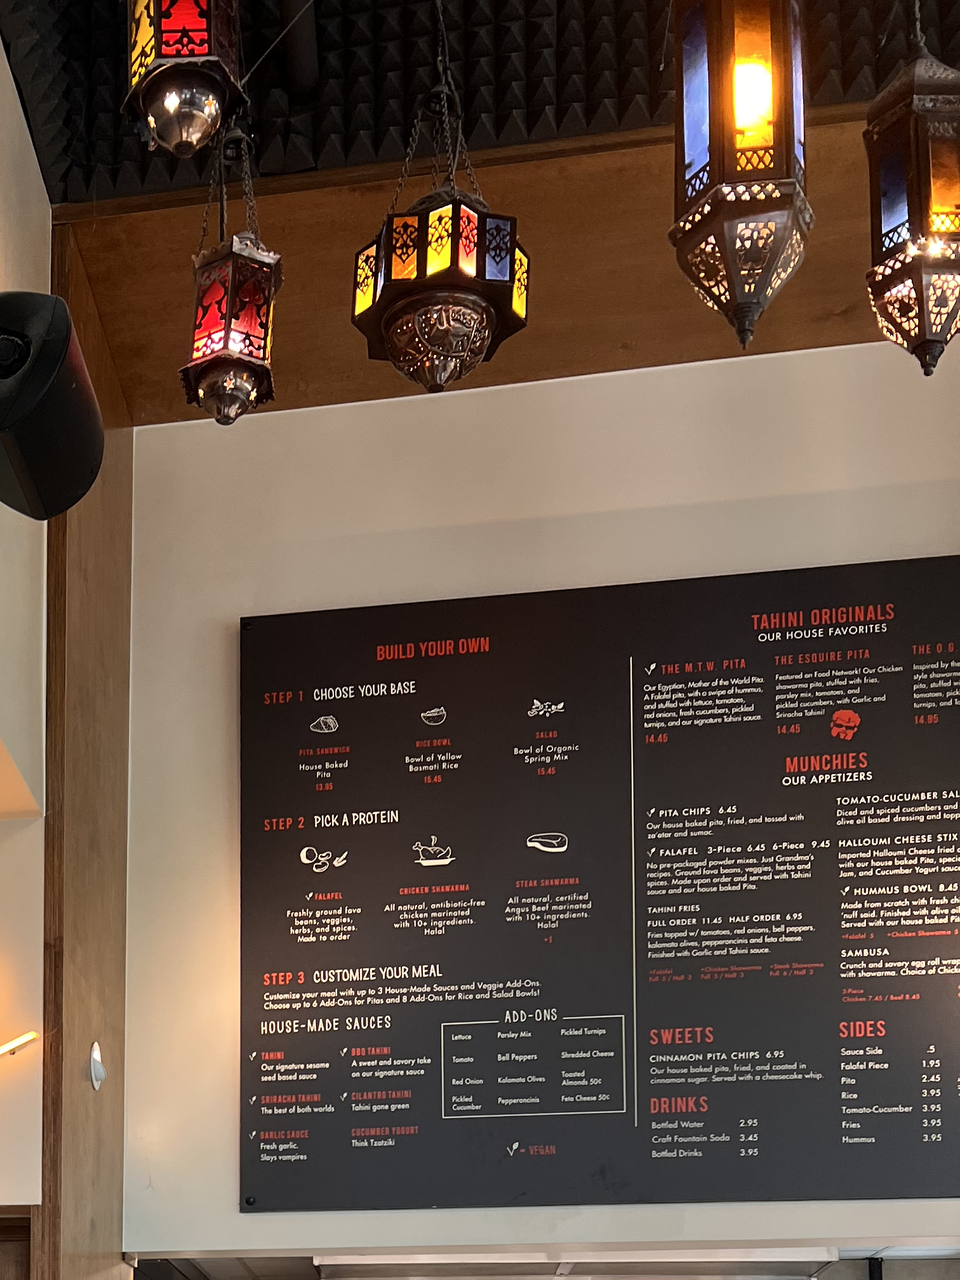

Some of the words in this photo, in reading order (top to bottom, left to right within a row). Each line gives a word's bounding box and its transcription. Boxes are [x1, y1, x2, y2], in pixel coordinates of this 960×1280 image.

[751, 610, 803, 630] TAHINI
[810, 603, 895, 626] ORIGINALS
[758, 632, 782, 642] OUR
[786, 628, 824, 640] HOUSE
[828, 623, 888, 636] FAVORITES
[376, 643, 415, 661] BUILD
[419, 640, 454, 657] YOUR
[458, 637, 490, 654] OWN
[912, 644, 931, 655] THE
[774, 655, 794, 666] THE
[798, 651, 842, 664] ESQUIRE
[847, 649, 870, 660] PITA
[661, 663, 680, 675] THE
[723, 658, 746, 670] PITA
[264, 691, 293, 705] STEP
[298, 690, 303, 702] 1
[313, 686, 355, 701] CHOOSE
[358, 683, 387, 697] YOUR
[390, 680, 417, 695] BASE
[535, 730, 558, 739] SALAD
[514, 745, 533, 755] Bowl
[535, 744, 544, 754] of
[546, 744, 579, 754] Organic
[405, 754, 424, 764] Bowl
[426, 753, 435, 762] of
[437, 752, 463, 761] Yellow
[524, 752, 551, 764] Spring
[553, 751, 569, 761] Mix
[786, 752, 868, 773] MUNCHIES
[325, 759, 349, 770] Baked
[409, 763, 440, 772] Basmati
[442, 762, 459, 770] Rice
[314, 769, 331, 779] Pita
[782, 775, 807, 786] OUR
[810, 771, 873, 784] APPETIZERS
[836, 791, 938, 806] TOMATO-CUCUMBER
[659, 809, 679, 818] PITA
[682, 807, 711, 816] CHIPS
[718, 805, 737, 814] 6.45
[264, 817, 293, 832] STEP
[298, 816, 305, 829] 2
[314, 814, 339, 828] PICK
[342, 813, 350, 827] A
[352, 810, 399, 825] PROTEIN
[838, 837, 891, 848] HALLOUMI
[894, 834, 933, 845] CHEESE
[937, 833, 958, 842] STIX
[659, 847, 698, 857] FALAFEL
[707, 845, 742, 854] 3-Piece
[747, 843, 766, 852] 6.45
[772, 842, 805, 851] 6-Piece
[811, 840, 831, 849] 9.45
[516, 880, 538, 888] STEAK
[540, 877, 580, 887] SHAWARMA
[399, 886, 429, 896] CHICKEN
[431, 884, 470, 893] SHAWARMA
[854, 885, 900, 896] HUMMUS
[903, 884, 933, 894] BOWL
[938, 882, 959, 892] 8.45
[314, 892, 343, 901] FALAFEL
[647, 906, 676, 914] TAHINI
[678, 904, 701, 912] FRIES
[668, 918, 697, 926] ORDER
[702, 916, 723, 925] 11.45
[729, 915, 750, 923] HALF
[752, 914, 781, 922] ORDER
[785, 912, 803, 921] 6.95
[841, 948, 890, 958] SAMBUSA
[263, 972, 293, 986] STEP
[297, 971, 305, 984] 3
[313, 967, 377, 984] CUSTOMIZE
[379, 966, 409, 980] YOUR
[412, 964, 443, 978] MEAL
[504, 1008, 558, 1024] ADD-ONS
[260, 1018, 340, 1035] HOUSE-MADE
[346, 1015, 391, 1030] SAUCES
[839, 1020, 886, 1038] SIDES
[650, 1027, 714, 1045] SWEETS
[261, 1052, 284, 1060] TAHINI
[351, 1047, 366, 1057] BBQ
[367, 1047, 391, 1055] TAHINI
[649, 1053, 703, 1063] CINNAMON
[707, 1052, 728, 1061] PITA
[730, 1051, 760, 1060] CHIPS
[765, 1050, 785, 1059] 6.95
[840, 1048, 864, 1056] Sauce
[865, 1046, 883, 1055] Side
[926, 1045, 936, 1054] .5
[840, 1061, 867, 1071] Falafel
[868, 1061, 889, 1069] Piece
[922, 1059, 941, 1068] 1.95
[841, 1077, 856, 1085] Pita
[921, 1074, 941, 1083] 2.45
[261, 1094, 296, 1104] SRIRACHA
[298, 1094, 321, 1102] TAHINI
[351, 1091, 387, 1101] CILANTRO
[388, 1090, 412, 1099] TAHINI
[841, 1091, 858, 1099] Rice
[922, 1089, 941, 1098] 3.95
[650, 1096, 708, 1114] DRINKS
[841, 1104, 913, 1114] Tomato-Cucumber
[922, 1104, 942, 1112] 3.95
[651, 1120, 678, 1130] Bottled
[680, 1120, 705, 1128] Water
[739, 1119, 758, 1127] 2.95
[842, 1121, 861, 1129] Fries
[922, 1118, 942, 1127] 3.95
[651, 1134, 672, 1144] Craft
[674, 1134, 708, 1143] Fountain
[709, 1133, 731, 1142] Soda
[739, 1133, 759, 1142] 3.45
[842, 1136, 876, 1144] Hummus
[923, 1133, 942, 1142] 3.95
[529, 1145, 556, 1155] VEGAN
[651, 1149, 677, 1158] Bottled
[678, 1148, 703, 1158] Drinks
[740, 1148, 759, 1157] 3.95
